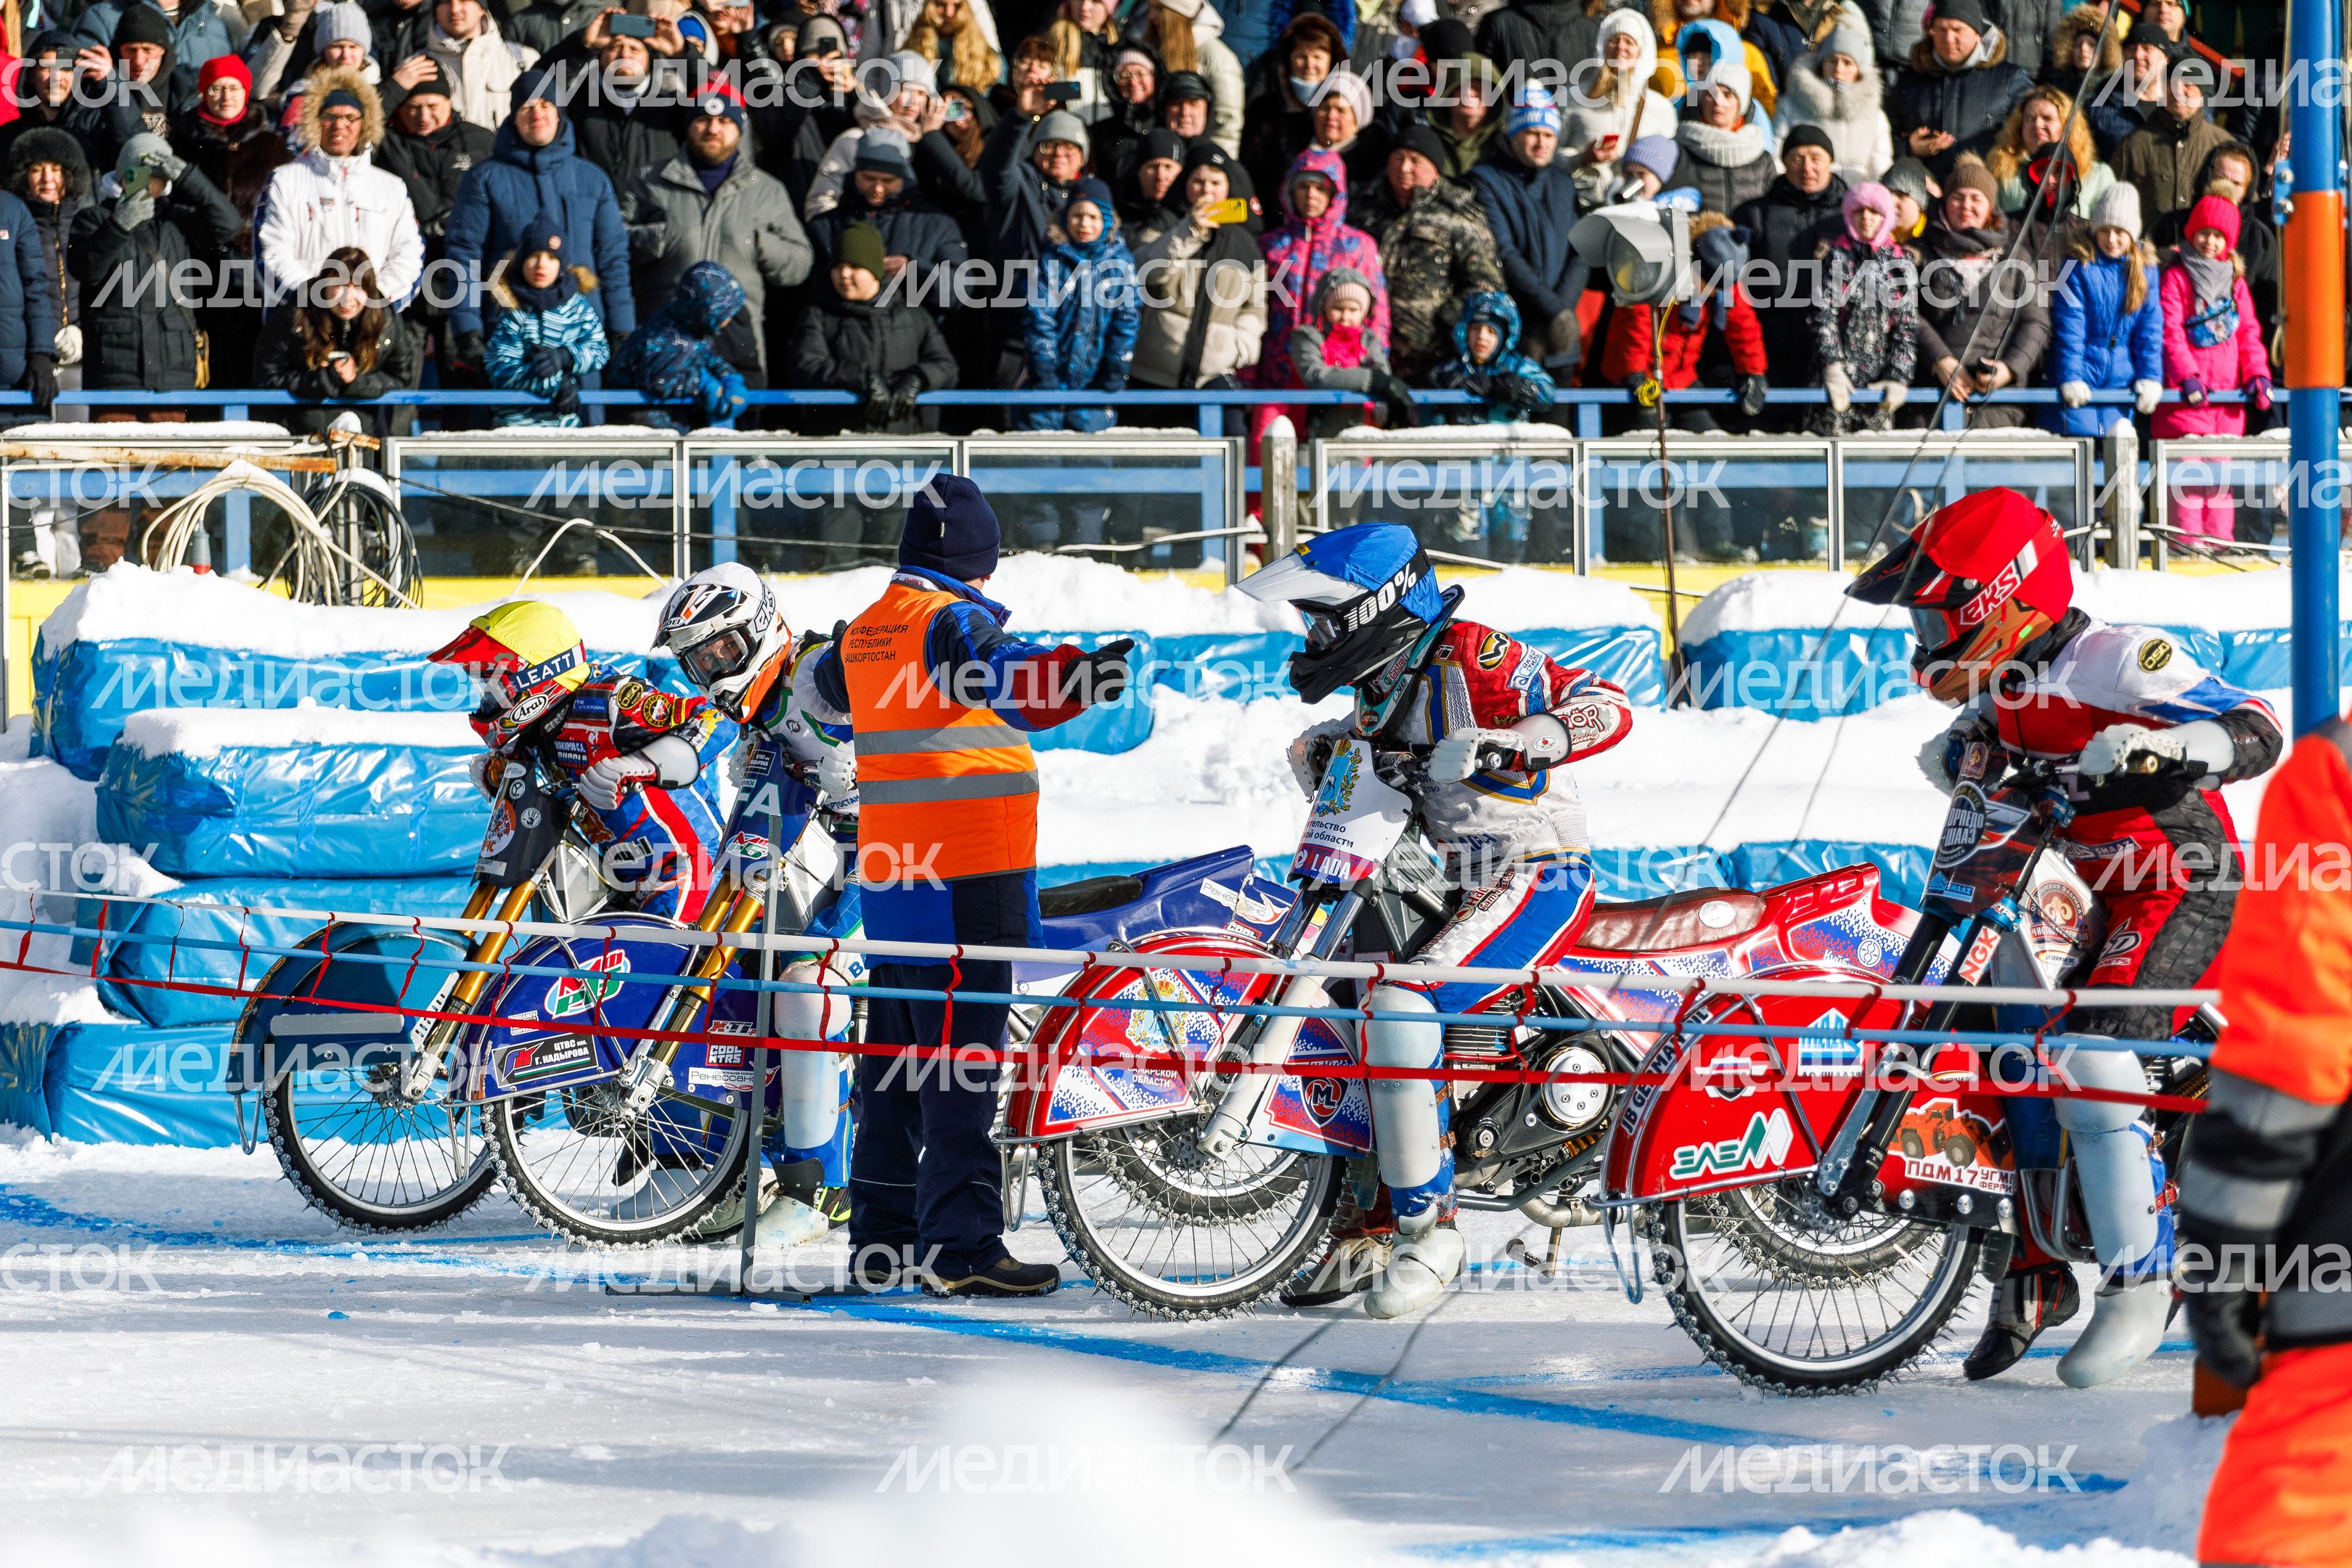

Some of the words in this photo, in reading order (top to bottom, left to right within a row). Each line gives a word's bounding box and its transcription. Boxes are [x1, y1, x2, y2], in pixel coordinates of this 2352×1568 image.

[1344, 563, 1416, 632] 100%
[859, 624, 909, 637] ФЕДЕРАЦИЯ
[515, 652, 571, 690] LEATT
[516, 698, 543, 718] Arai
[1314, 831, 1354, 849] области
[1944, 828, 1977, 846] ШААЗ
[1310, 853, 1351, 881] LADA
[1960, 926, 1998, 982] NGK
[542, 1047, 589, 1063] КАДЫРОВА
[554, 1040, 576, 1052] ЦТВС
[1132, 1074, 1171, 1087] ОБЛАСТИ
